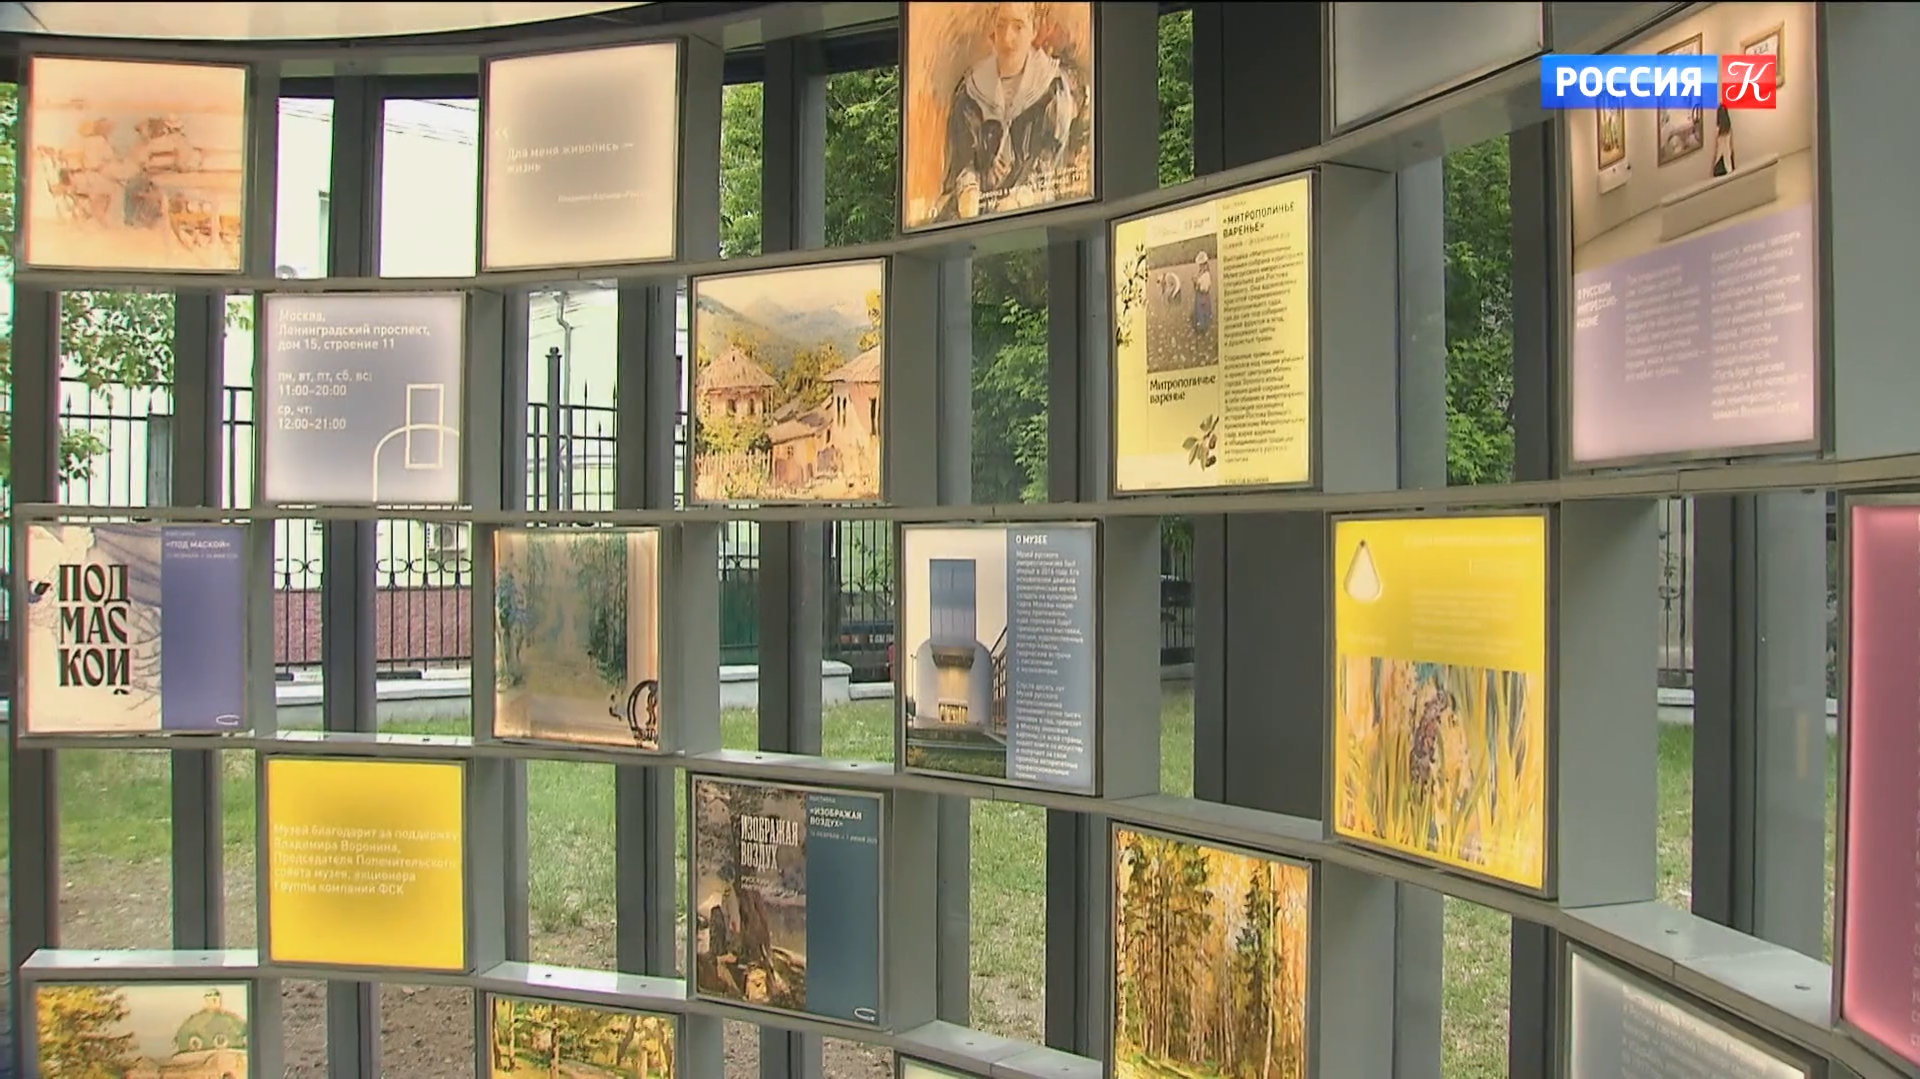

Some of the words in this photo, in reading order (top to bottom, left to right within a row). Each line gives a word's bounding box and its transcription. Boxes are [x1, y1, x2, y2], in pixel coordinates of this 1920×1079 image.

[507, 148, 528, 162] Для
[531, 148, 559, 157] меня
[562, 143, 619, 155] живопись
[507, 164, 541, 173] жизнь
[1223, 202, 1294, 224] «МИТРОПОЛИЧЬЕ
[1223, 222, 1265, 238] ВАРЕНЬЕ»
[279, 310, 326, 323] Москва,
[278, 324, 370, 337] Ленинградский
[373, 327, 430, 336] проспект,
[278, 341, 300, 351] дом
[305, 339, 321, 350] 15,
[324, 341, 378, 351] строение
[383, 339, 394, 348] 11
[279, 373, 295, 382] пн,
[299, 373, 314, 382] вт,
[317, 373, 332, 382] пт,
[356, 373, 372, 381] вс:
[1150, 392, 1185, 405] варенье
[278, 406, 294, 416] ср,
[165, 541, 189, 549] «ПОД
[190, 540, 230, 548] МАСКОЙ»
[1016, 535, 1021, 543] О
[1023, 535, 1047, 544] МУЗЕЕ
[59, 564, 131, 606] ПОД
[60, 607, 128, 644] МАС
[59, 648, 130, 695] КОЙ
[810, 808, 862, 820] «ИЗОБРАЖАЯ
[810, 817, 843, 827] ВОЗДУХ»
[274, 825, 308, 838] Музей
[312, 825, 377, 839] благодарит
[379, 828, 392, 837] за
[741, 815, 798, 847] ИЗОБРАЖАЯ
[275, 841, 337, 851] Владимира
[341, 841, 401, 853] Воронина,
[275, 853, 353, 865] Председателя
[741, 842, 778, 871] ВОЗДУХ
[315, 869, 350, 881] музея,
[319, 883, 375, 895] компаний
[379, 884, 403, 895] ФСК
